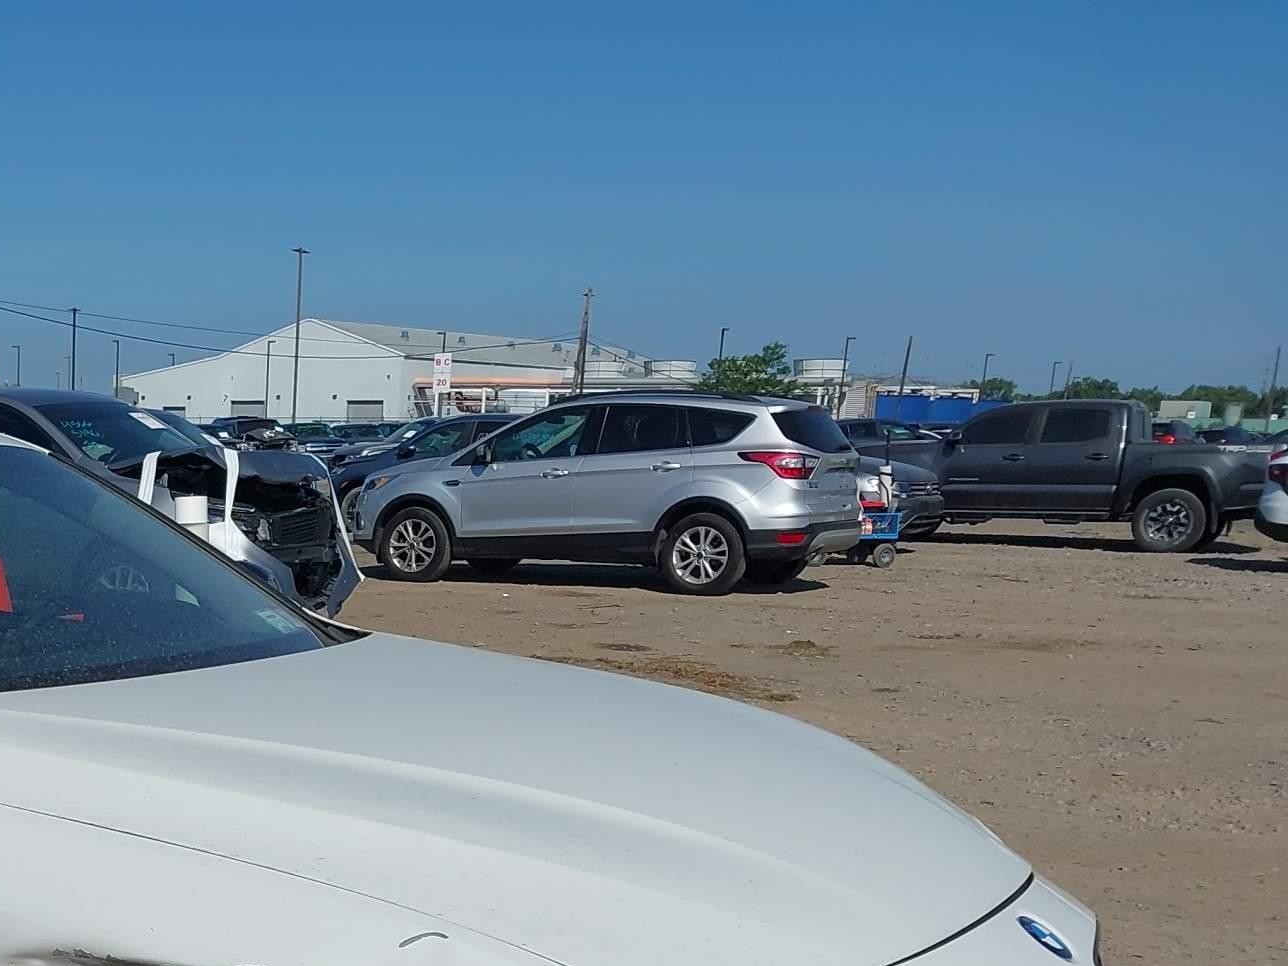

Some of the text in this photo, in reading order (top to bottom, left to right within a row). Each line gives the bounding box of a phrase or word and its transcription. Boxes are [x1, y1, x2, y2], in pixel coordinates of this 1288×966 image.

[435, 358, 451, 366] B C
[435, 379, 447, 387] 20
